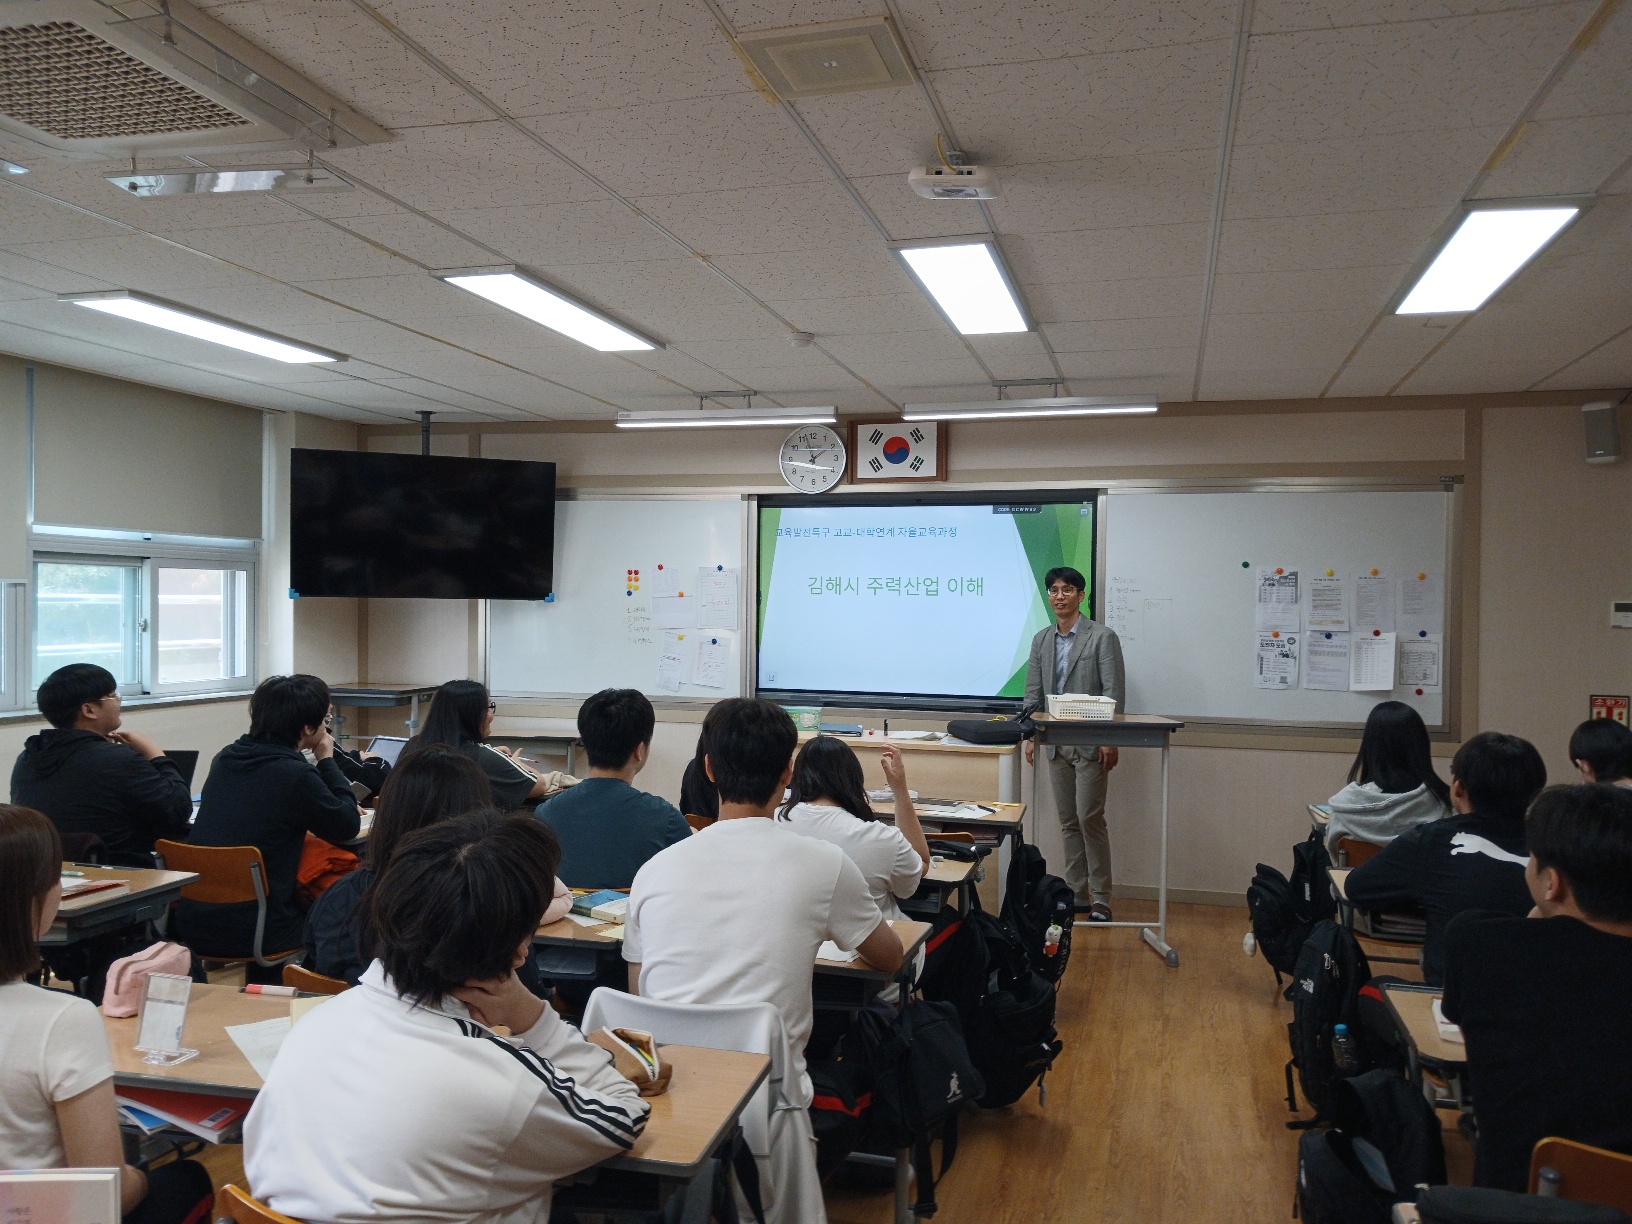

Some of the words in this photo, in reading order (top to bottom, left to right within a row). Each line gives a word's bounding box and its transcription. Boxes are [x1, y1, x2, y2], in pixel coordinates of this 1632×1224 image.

[809, 432, 817, 440] 12
[833, 454, 839, 462] 3
[791, 467, 797, 475] 8
[811, 478, 816, 486] 6
[775, 527, 831, 538] 교육발전특구
[833, 527, 895, 538] 고교-대학연계
[897, 526, 957, 538] 자율교육과정
[807, 576, 860, 596] 김해시
[866, 576, 939, 597] 주력산업
[947, 576, 984, 597] 이해
[1594, 698, 1626, 707] 소화기
